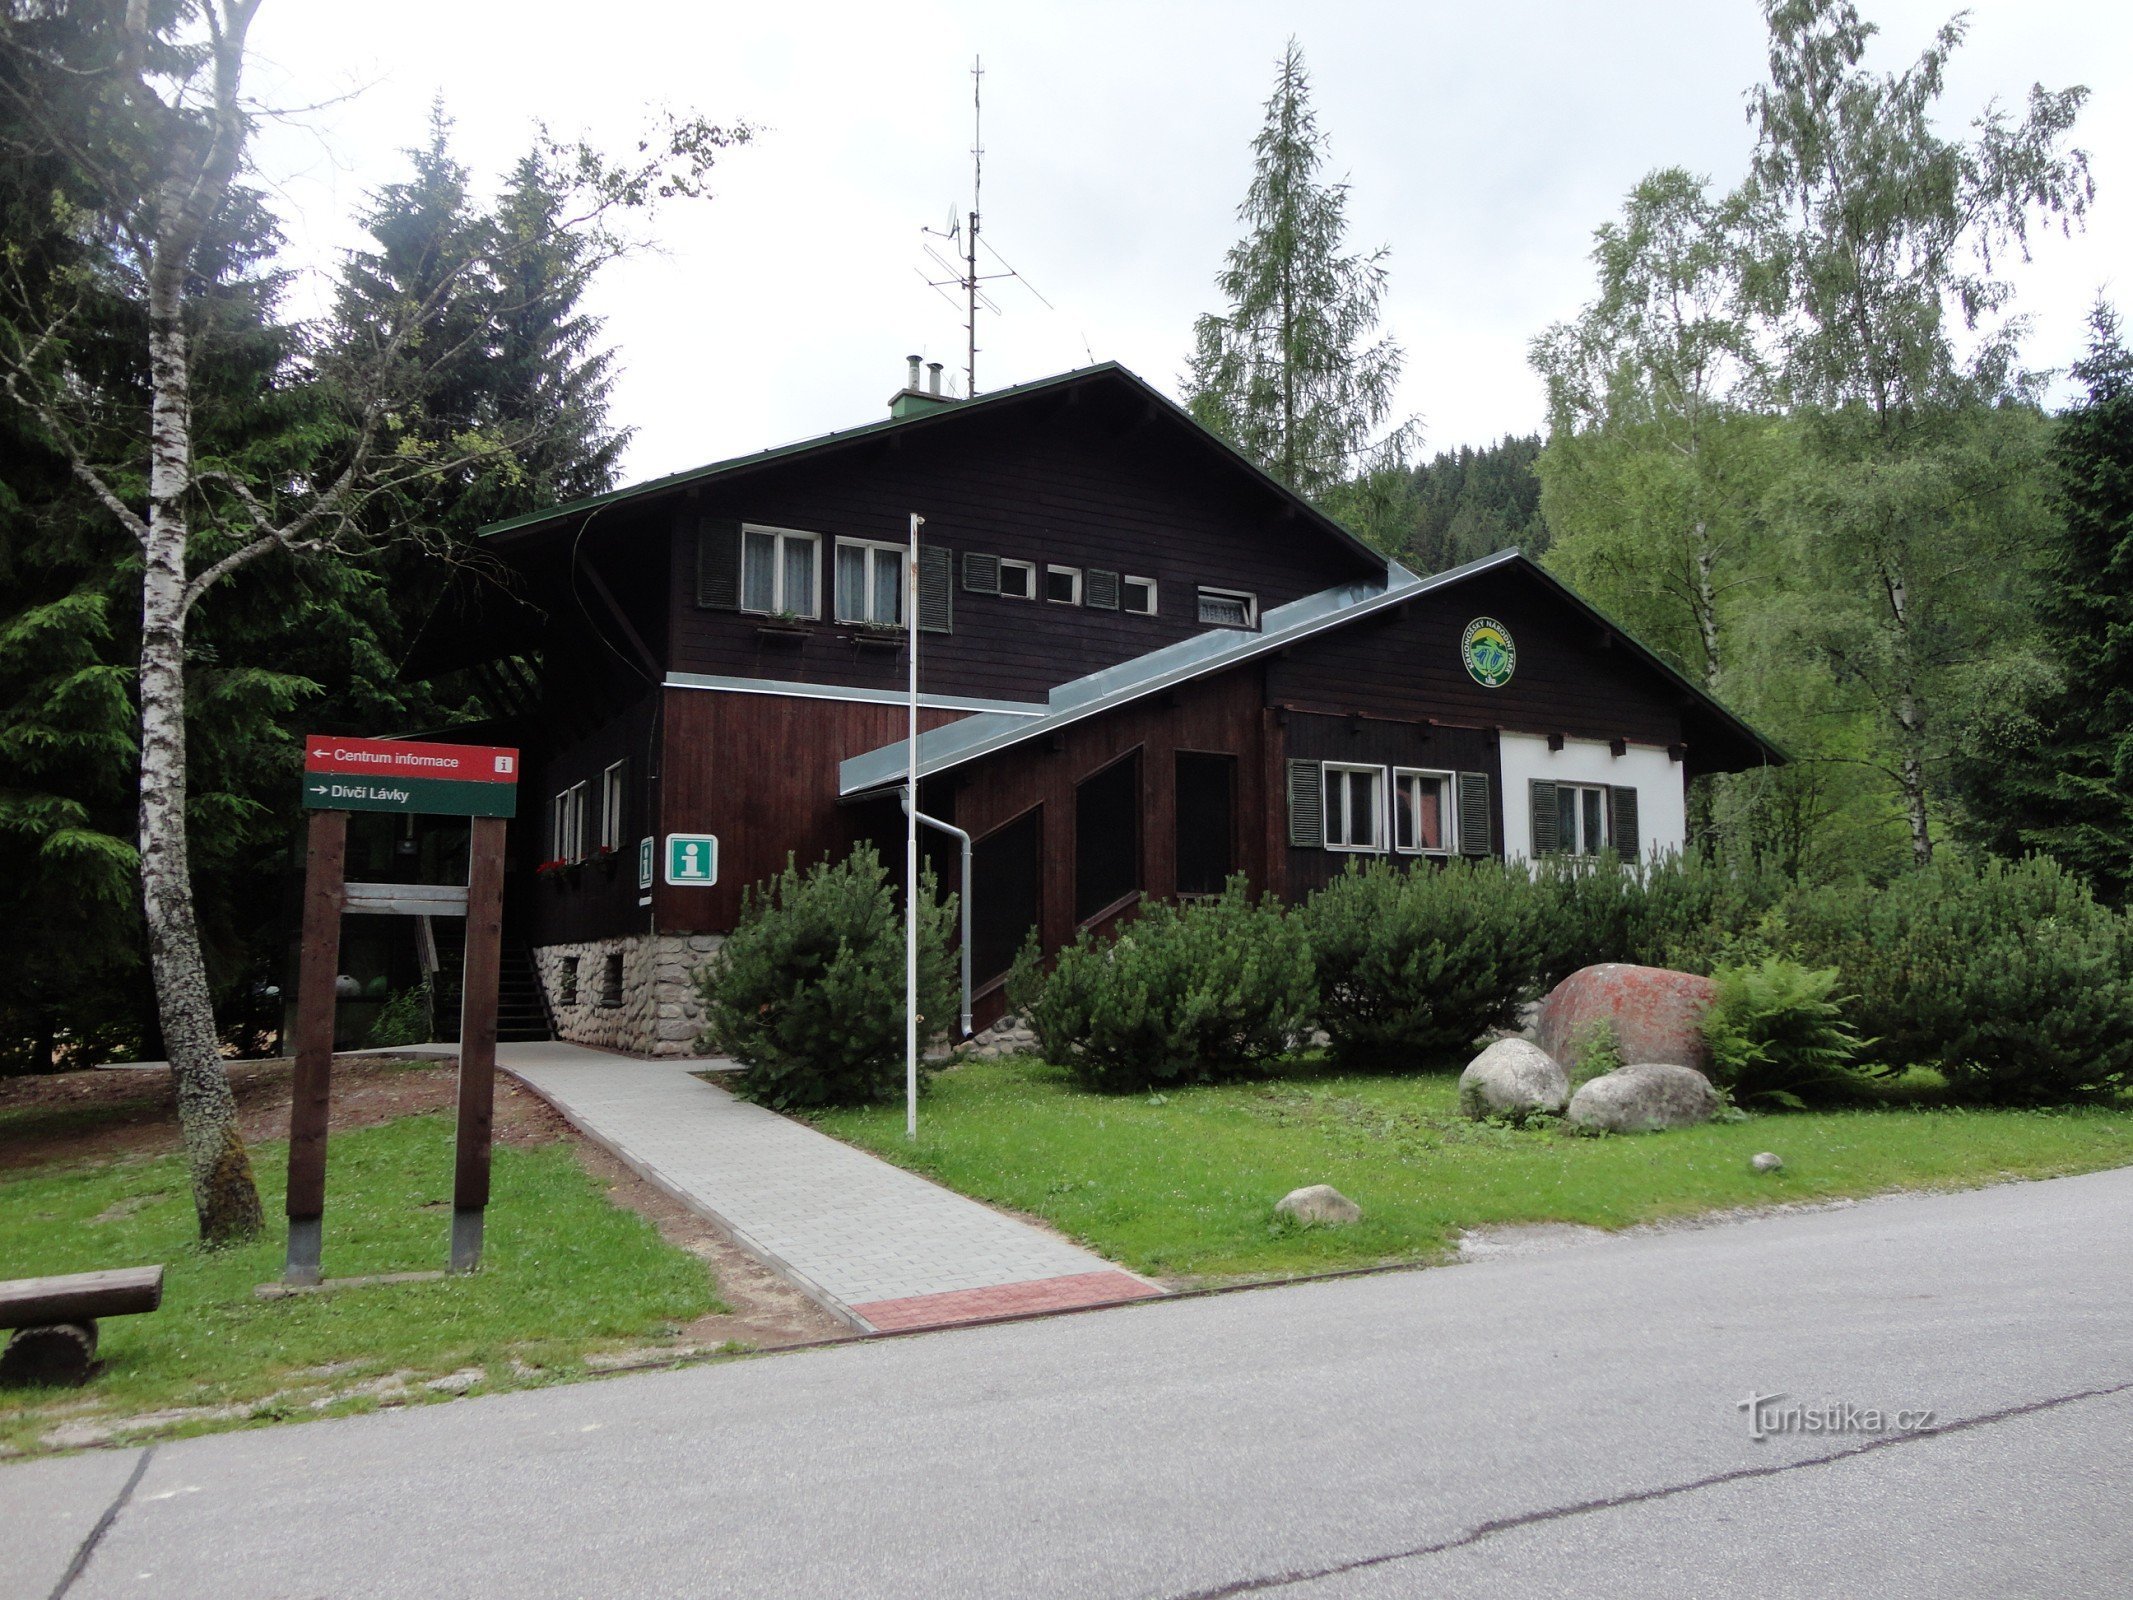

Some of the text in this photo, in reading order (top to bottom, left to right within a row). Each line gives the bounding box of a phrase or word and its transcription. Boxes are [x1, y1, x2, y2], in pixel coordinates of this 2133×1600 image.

[1504, 653, 1514, 675] PARK
[334, 748, 459, 768] Centrum informace
[331, 784, 410, 804] Dívčí Lávky
